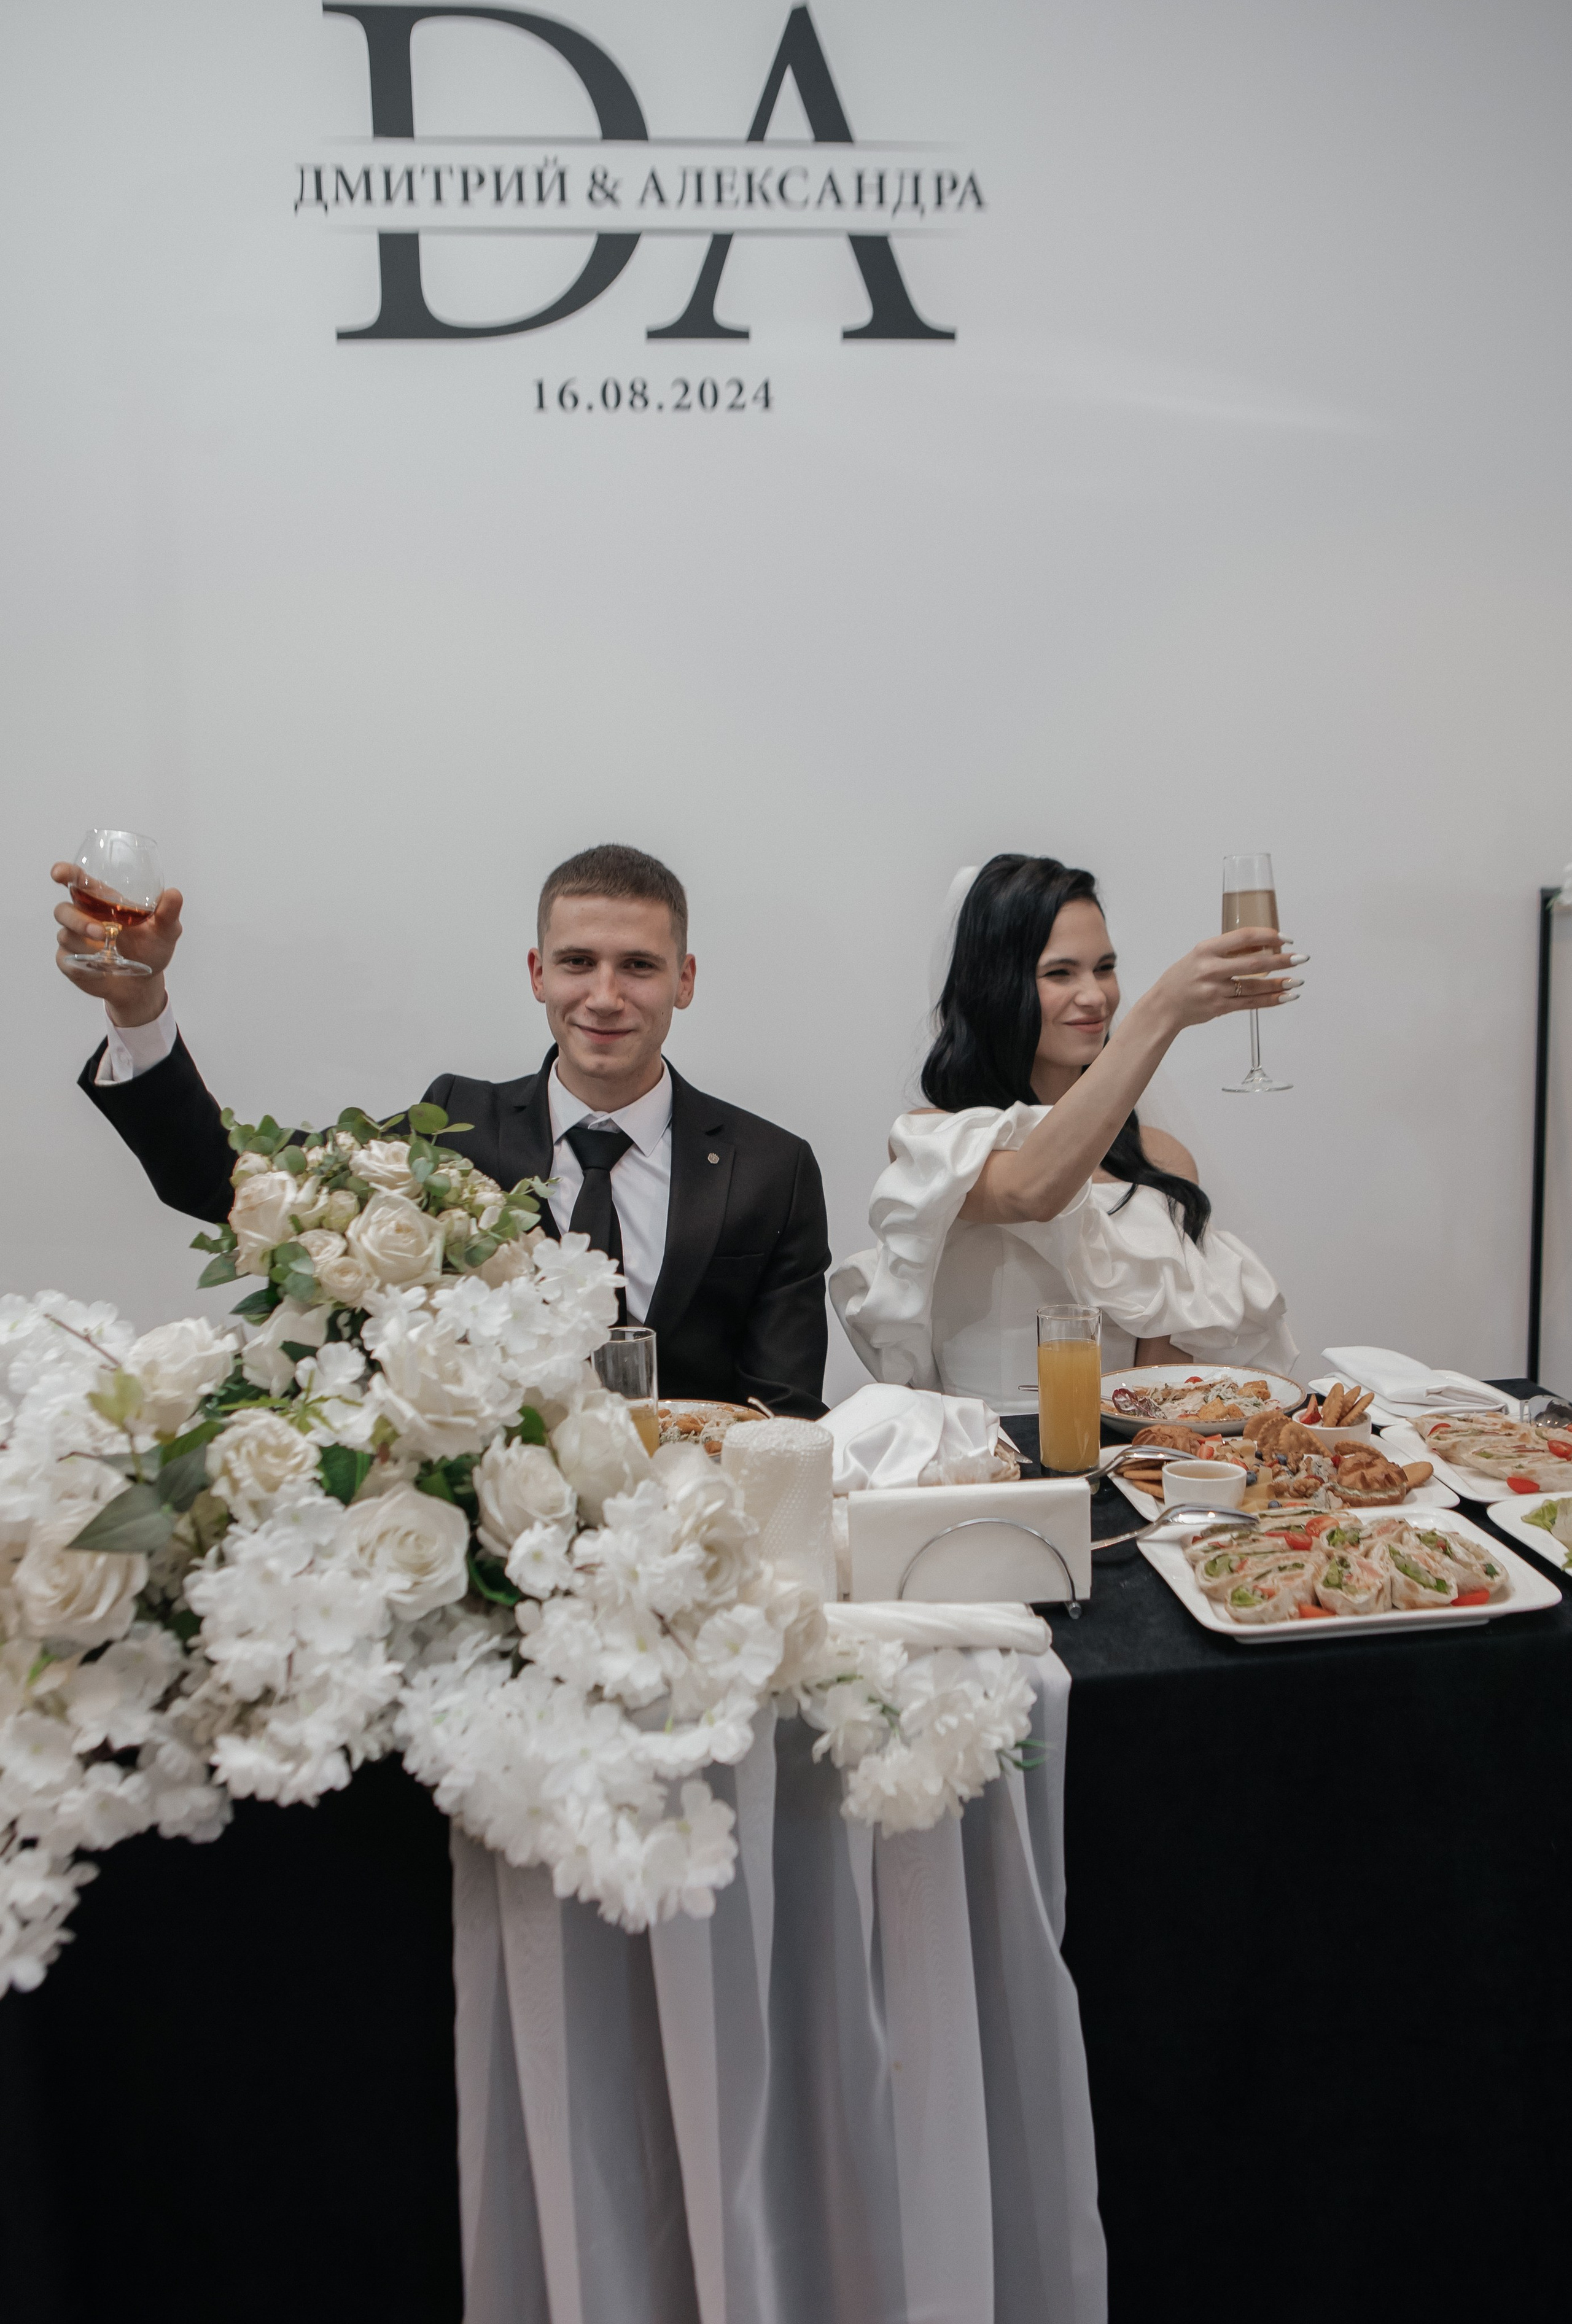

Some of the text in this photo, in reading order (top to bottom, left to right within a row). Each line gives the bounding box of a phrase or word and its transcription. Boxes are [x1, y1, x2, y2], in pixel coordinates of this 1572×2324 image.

[293, 155, 989, 220] ДМИТРИЙ & АЛЕКСАНДРА
[533, 376, 774, 413] 16.08.2024
